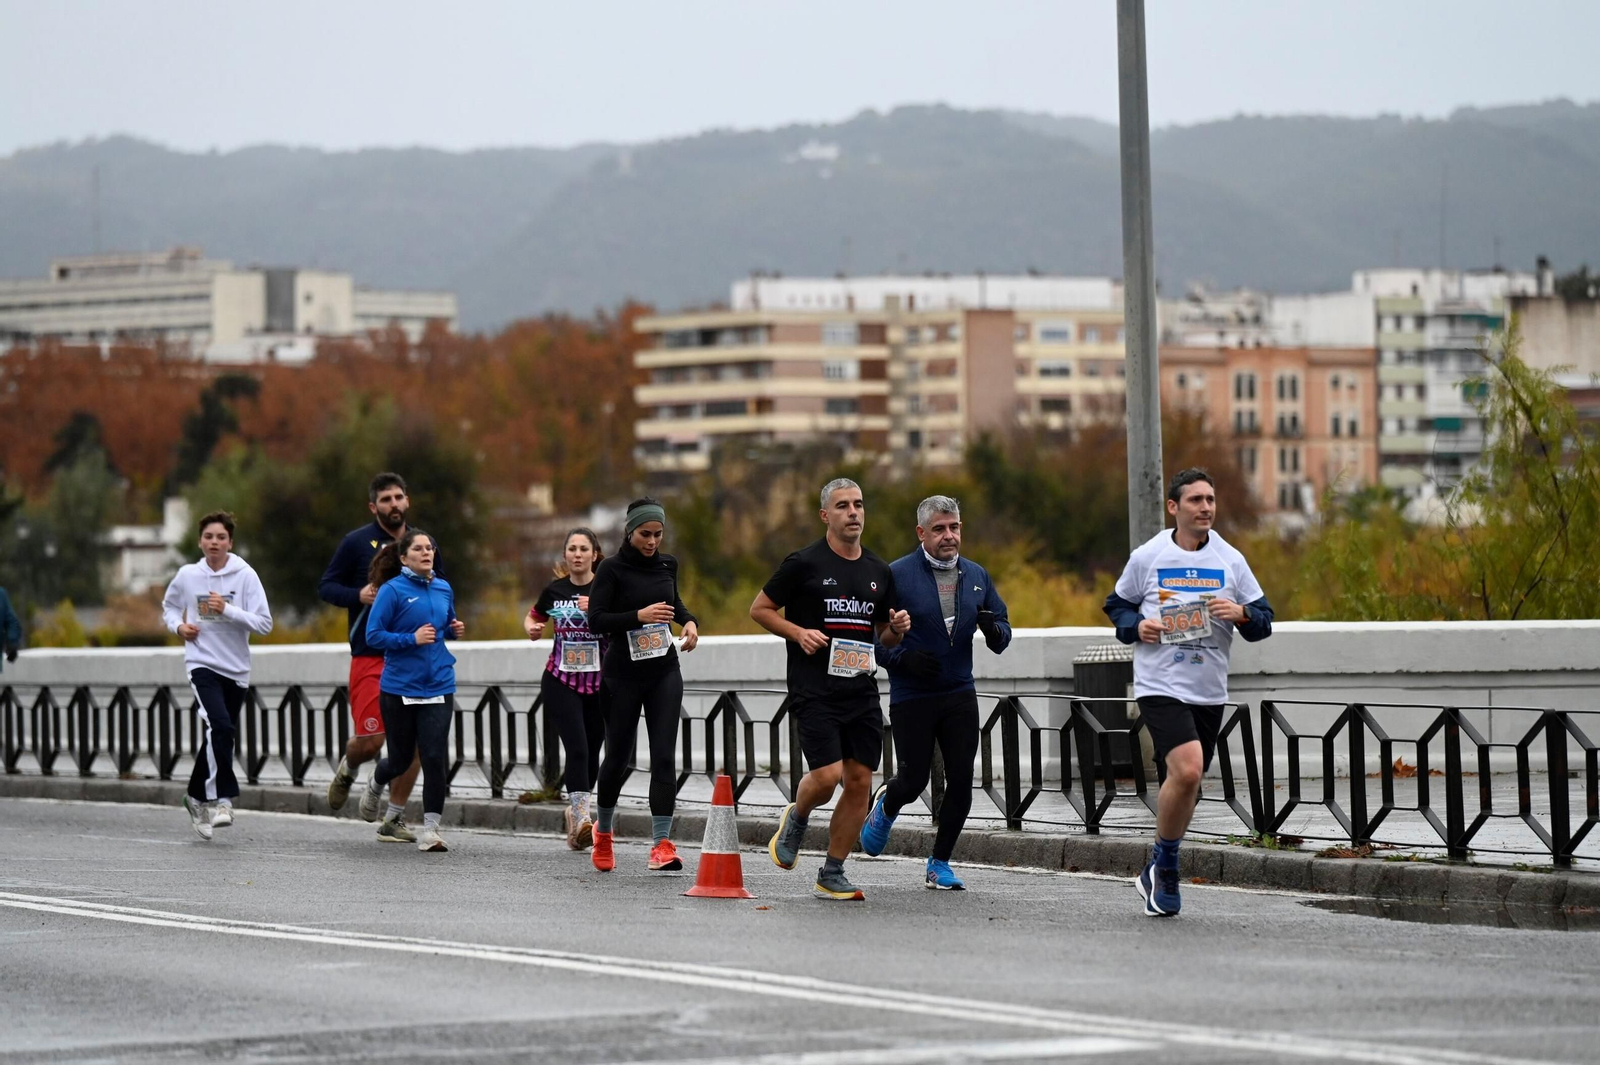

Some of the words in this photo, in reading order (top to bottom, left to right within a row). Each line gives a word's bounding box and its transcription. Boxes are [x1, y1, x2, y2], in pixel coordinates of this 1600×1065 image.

[1186, 570, 1198, 578] 12
[1161, 610, 1203, 634] 364
[637, 632, 663, 650] 95
[566, 650, 587, 665] 91
[833, 649, 870, 670] 202
